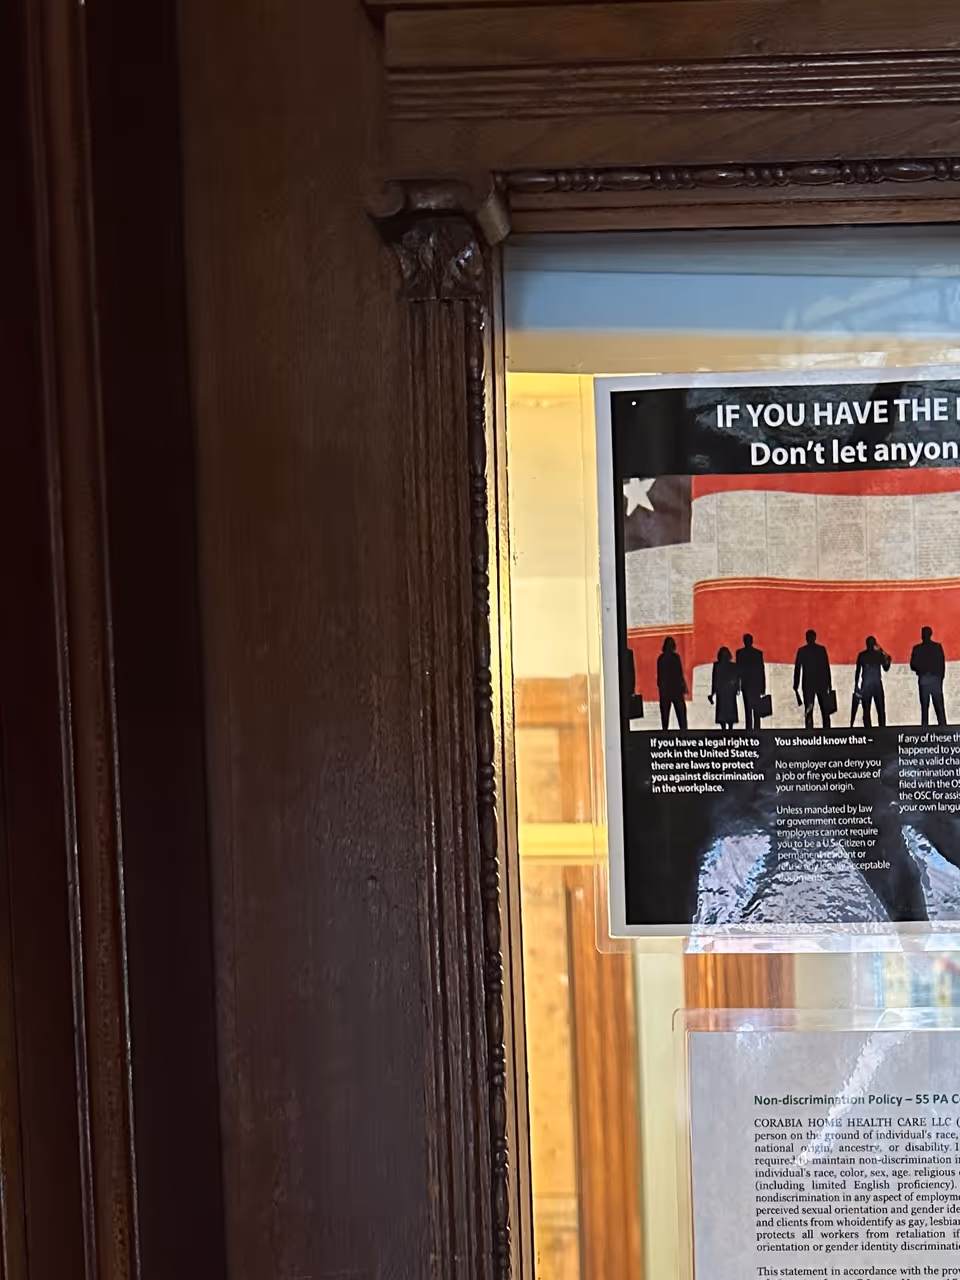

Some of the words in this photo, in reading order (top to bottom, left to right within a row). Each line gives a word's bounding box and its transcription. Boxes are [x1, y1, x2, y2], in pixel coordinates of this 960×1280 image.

[716, 404, 739, 427] IF
[746, 403, 804, 427] YOU
[813, 400, 888, 425] HAVE
[893, 397, 948, 421] THE
[832, 439, 867, 463] let
[650, 737, 656, 747] If
[657, 739, 674, 749] you
[675, 737, 696, 746] have
[704, 737, 726, 748] legal
[727, 737, 748, 748] right
[749, 738, 759, 746] to
[774, 737, 791, 746] You
[792, 736, 821, 745] should
[822, 736, 847, 744] know
[848, 735, 866, 744] that
[650, 749, 672, 758] work
[673, 749, 682, 757] in
[683, 749, 698, 758] the
[699, 748, 729, 758] United
[730, 748, 759, 758] States,
[650, 761, 674, 770] there
[690, 760, 710, 769] laws
[711, 761, 721, 769] to
[721, 761, 754, 770] protect
[651, 774, 668, 783] you
[668, 772, 701, 783] against
[702, 771, 764, 780] discrimination
[652, 784, 660, 793] in
[661, 783, 676, 792] the
[677, 783, 724, 793] workplace.
[754, 1094, 865, 1106] Non-discrimination
[868, 1094, 902, 1106] Policy
[915, 1093, 929, 1104] 55
[932, 1093, 948, 1104] PA
[756, 1266, 778, 1276] This
[779, 1267, 828, 1275] statement
[843, 1265, 897, 1275] accordance
[899, 1265, 921, 1275] with
[923, 1265, 939, 1275] the
